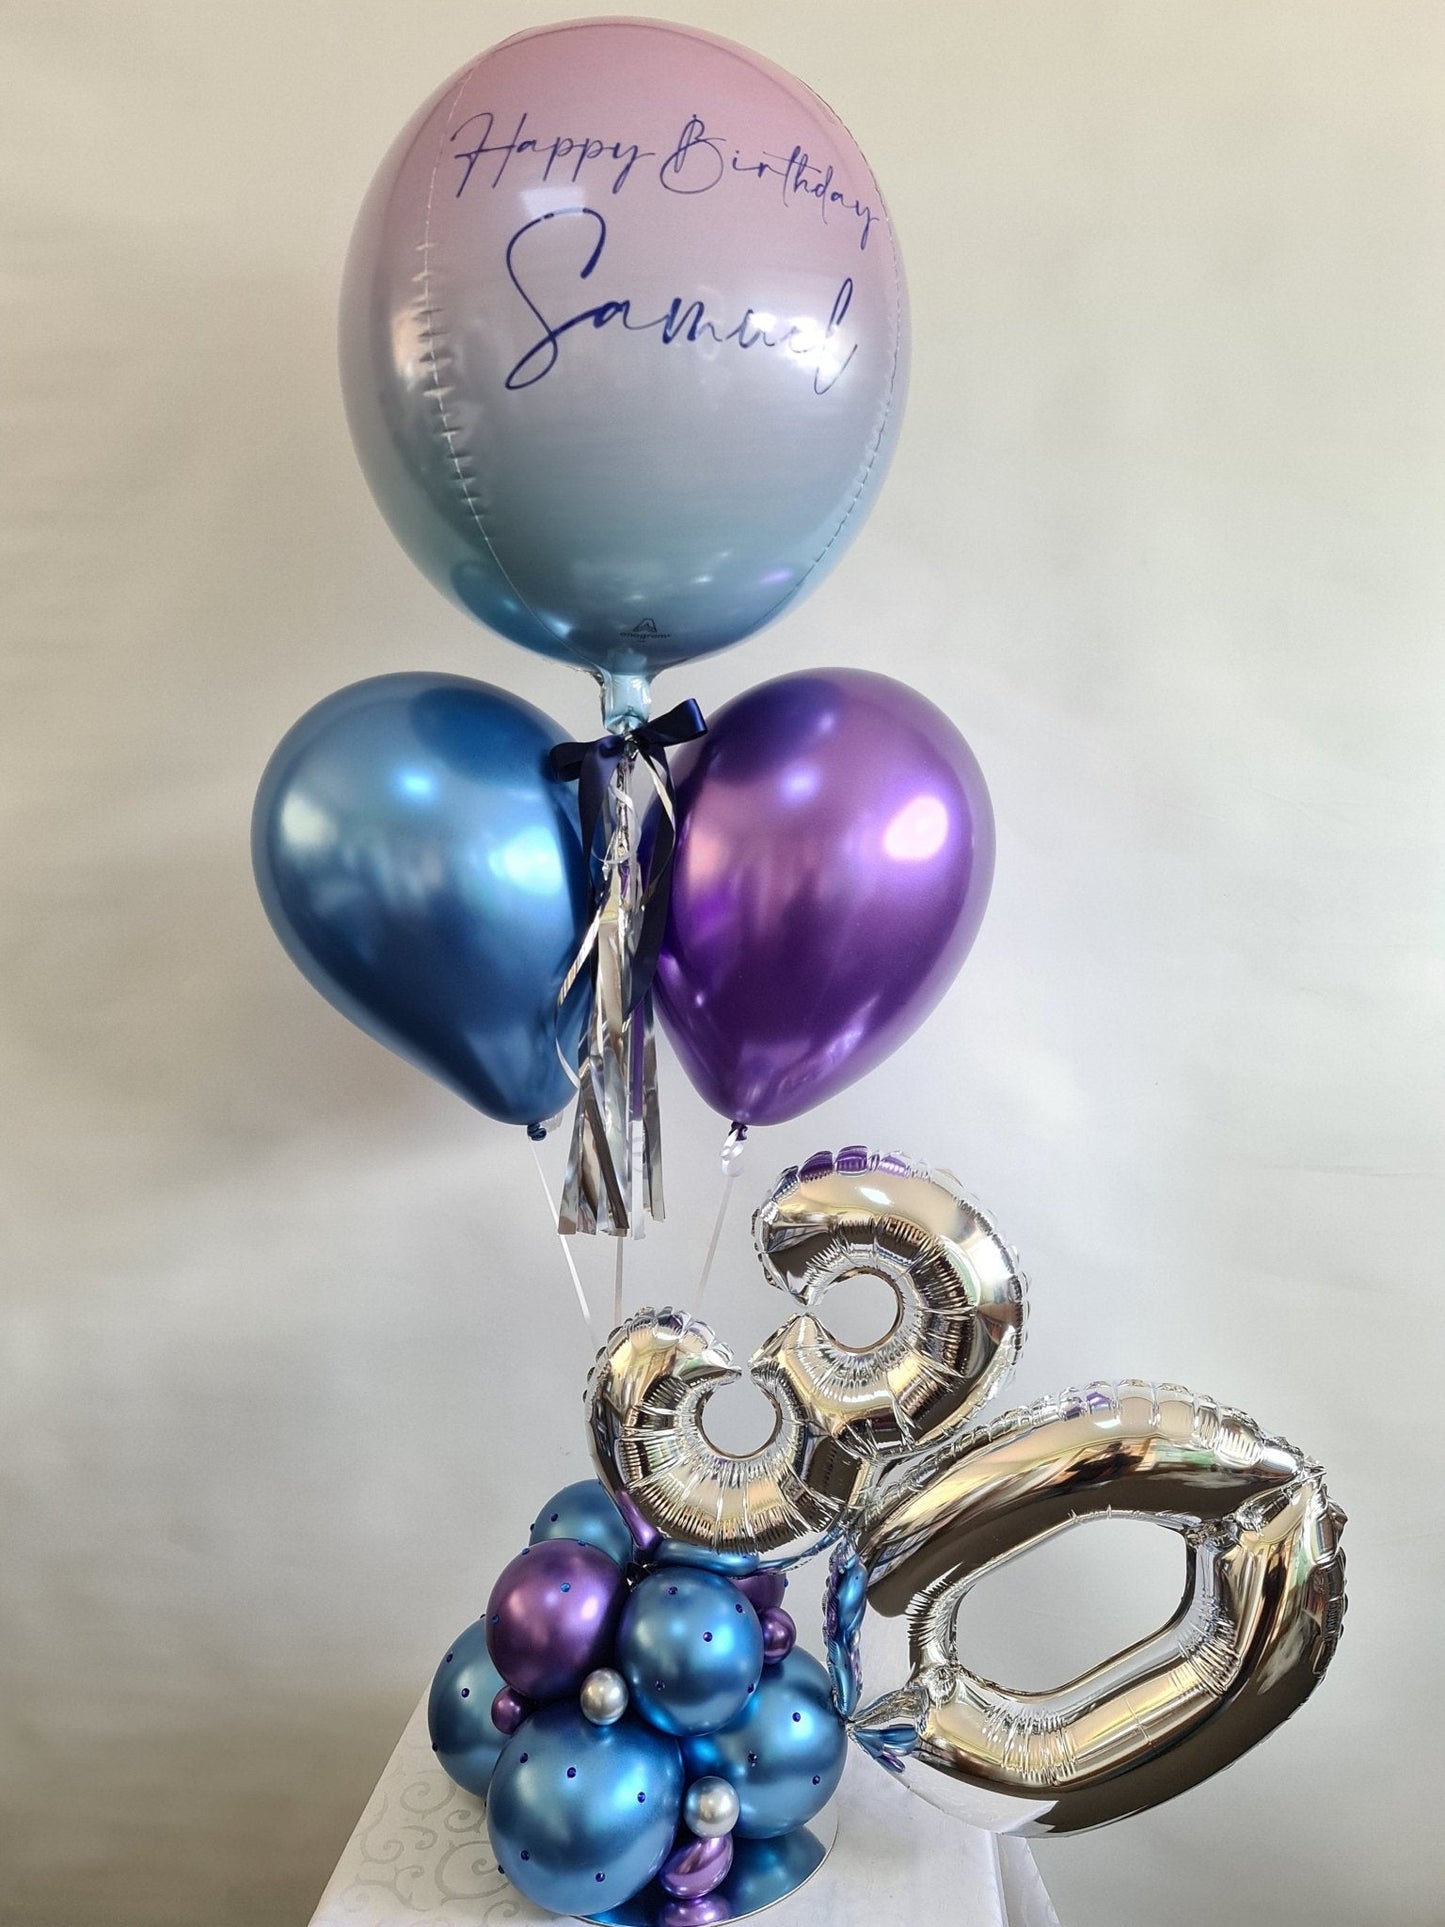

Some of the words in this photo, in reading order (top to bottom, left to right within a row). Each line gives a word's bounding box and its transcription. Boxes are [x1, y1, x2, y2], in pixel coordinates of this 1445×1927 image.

[449, 112, 656, 199] Happy
[659, 113, 880, 250] Birthday
[504, 206, 858, 395] Samuel
